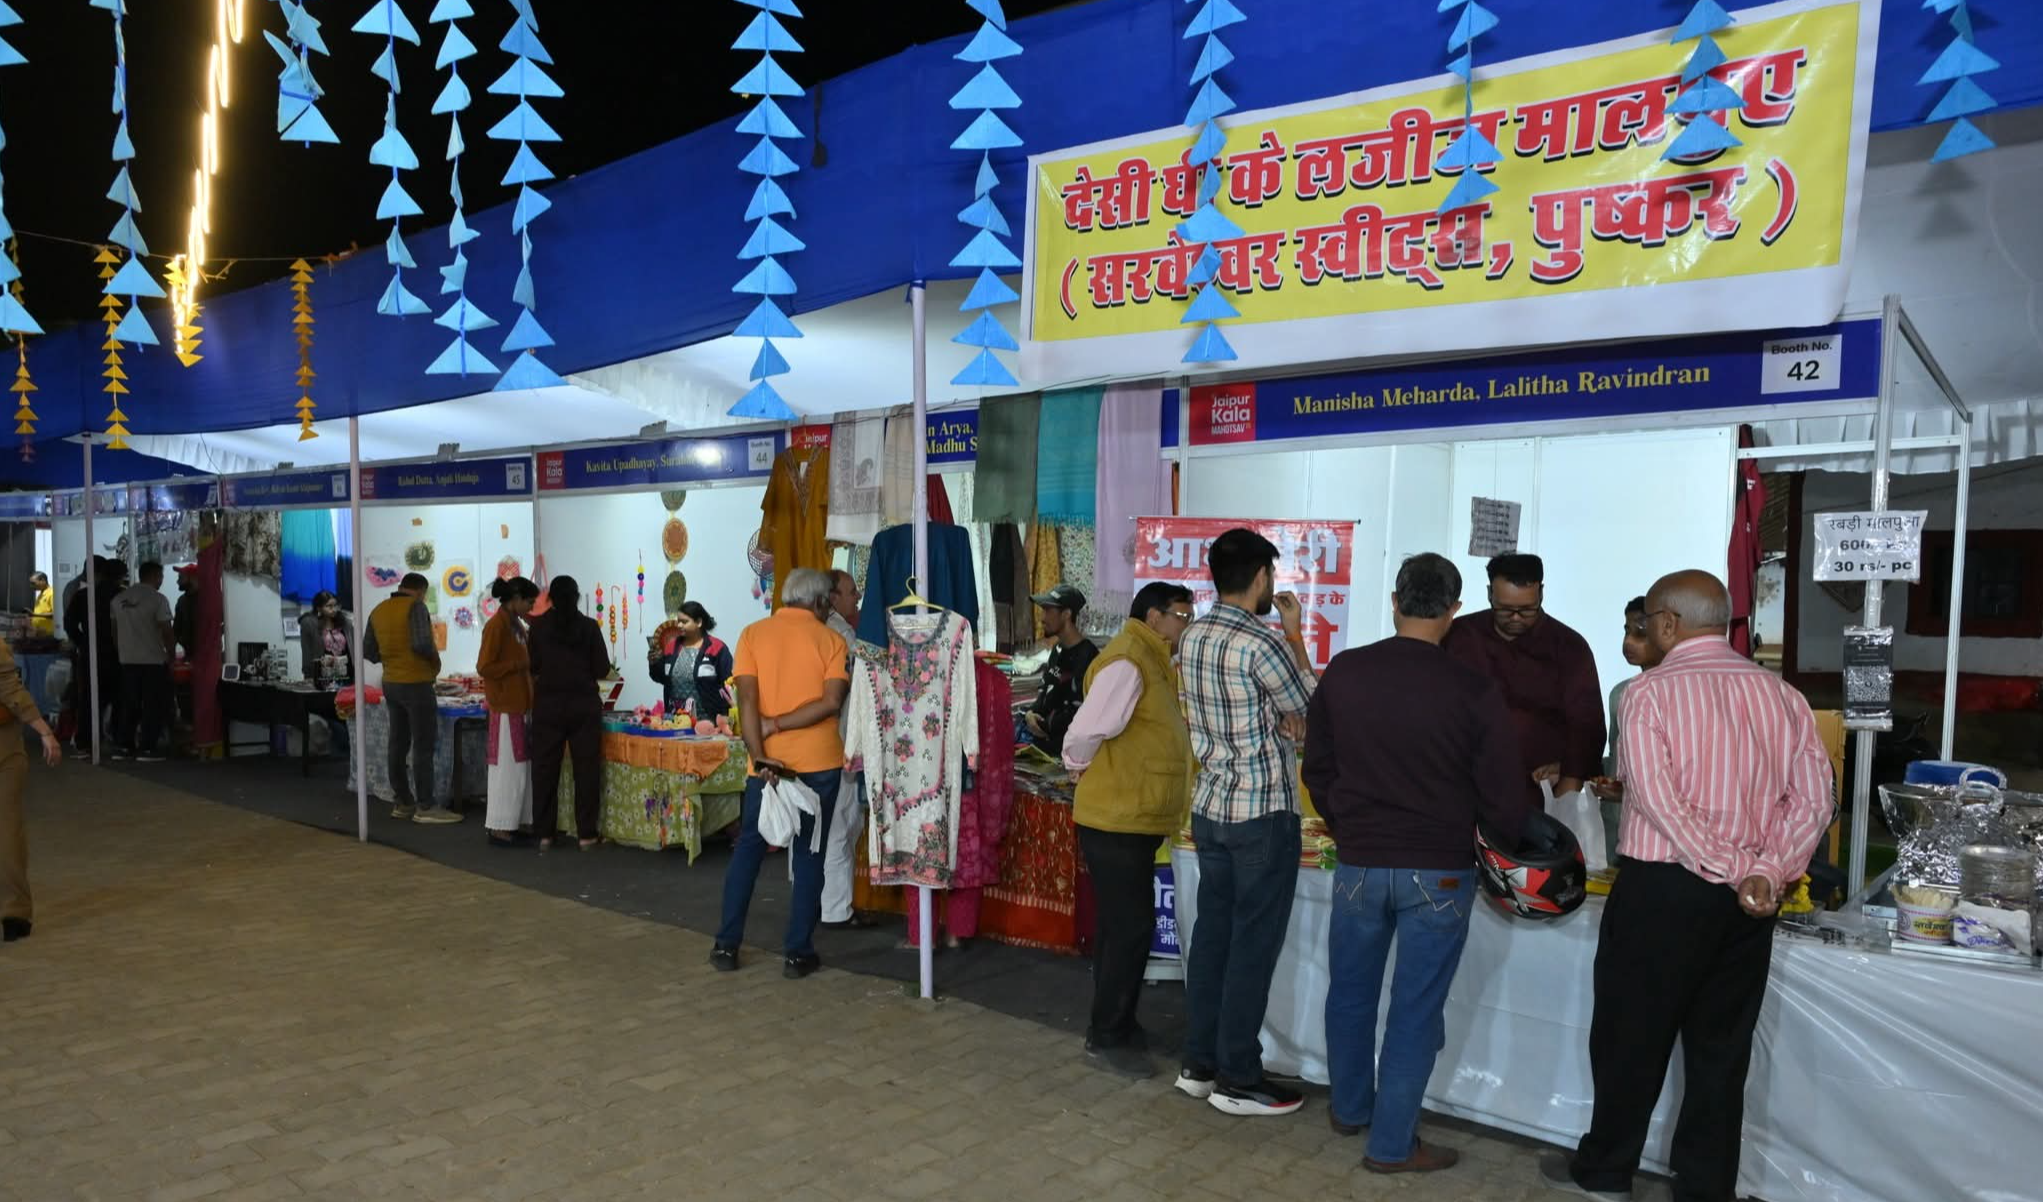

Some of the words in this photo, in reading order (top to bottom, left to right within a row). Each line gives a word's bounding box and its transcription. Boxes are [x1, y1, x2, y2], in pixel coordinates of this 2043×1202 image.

[1062, 158, 1157, 233] देसी
[1226, 131, 1286, 208] के
[1512, 47, 1807, 166] मालए
[1771, 341, 1808, 355] Booth
[1812, 340, 1833, 352] No.
[1786, 360, 1820, 381] 42
[1293, 391, 1375, 416] Manisha
[1382, 382, 1482, 408] Meharda,
[1487, 374, 1569, 399] Lalitha
[1577, 364, 1711, 394] Ravindran
[1211, 394, 1251, 409] Jaipur
[1211, 406, 1251, 424] Kala
[926, 437, 966, 455] Madhu
[585, 460, 611, 474] Kavita
[756, 452, 768, 464] 44
[1829, 515, 1861, 533] रबड़ी
[1834, 561, 1854, 572] 30
[1891, 561, 1912, 573] pc
